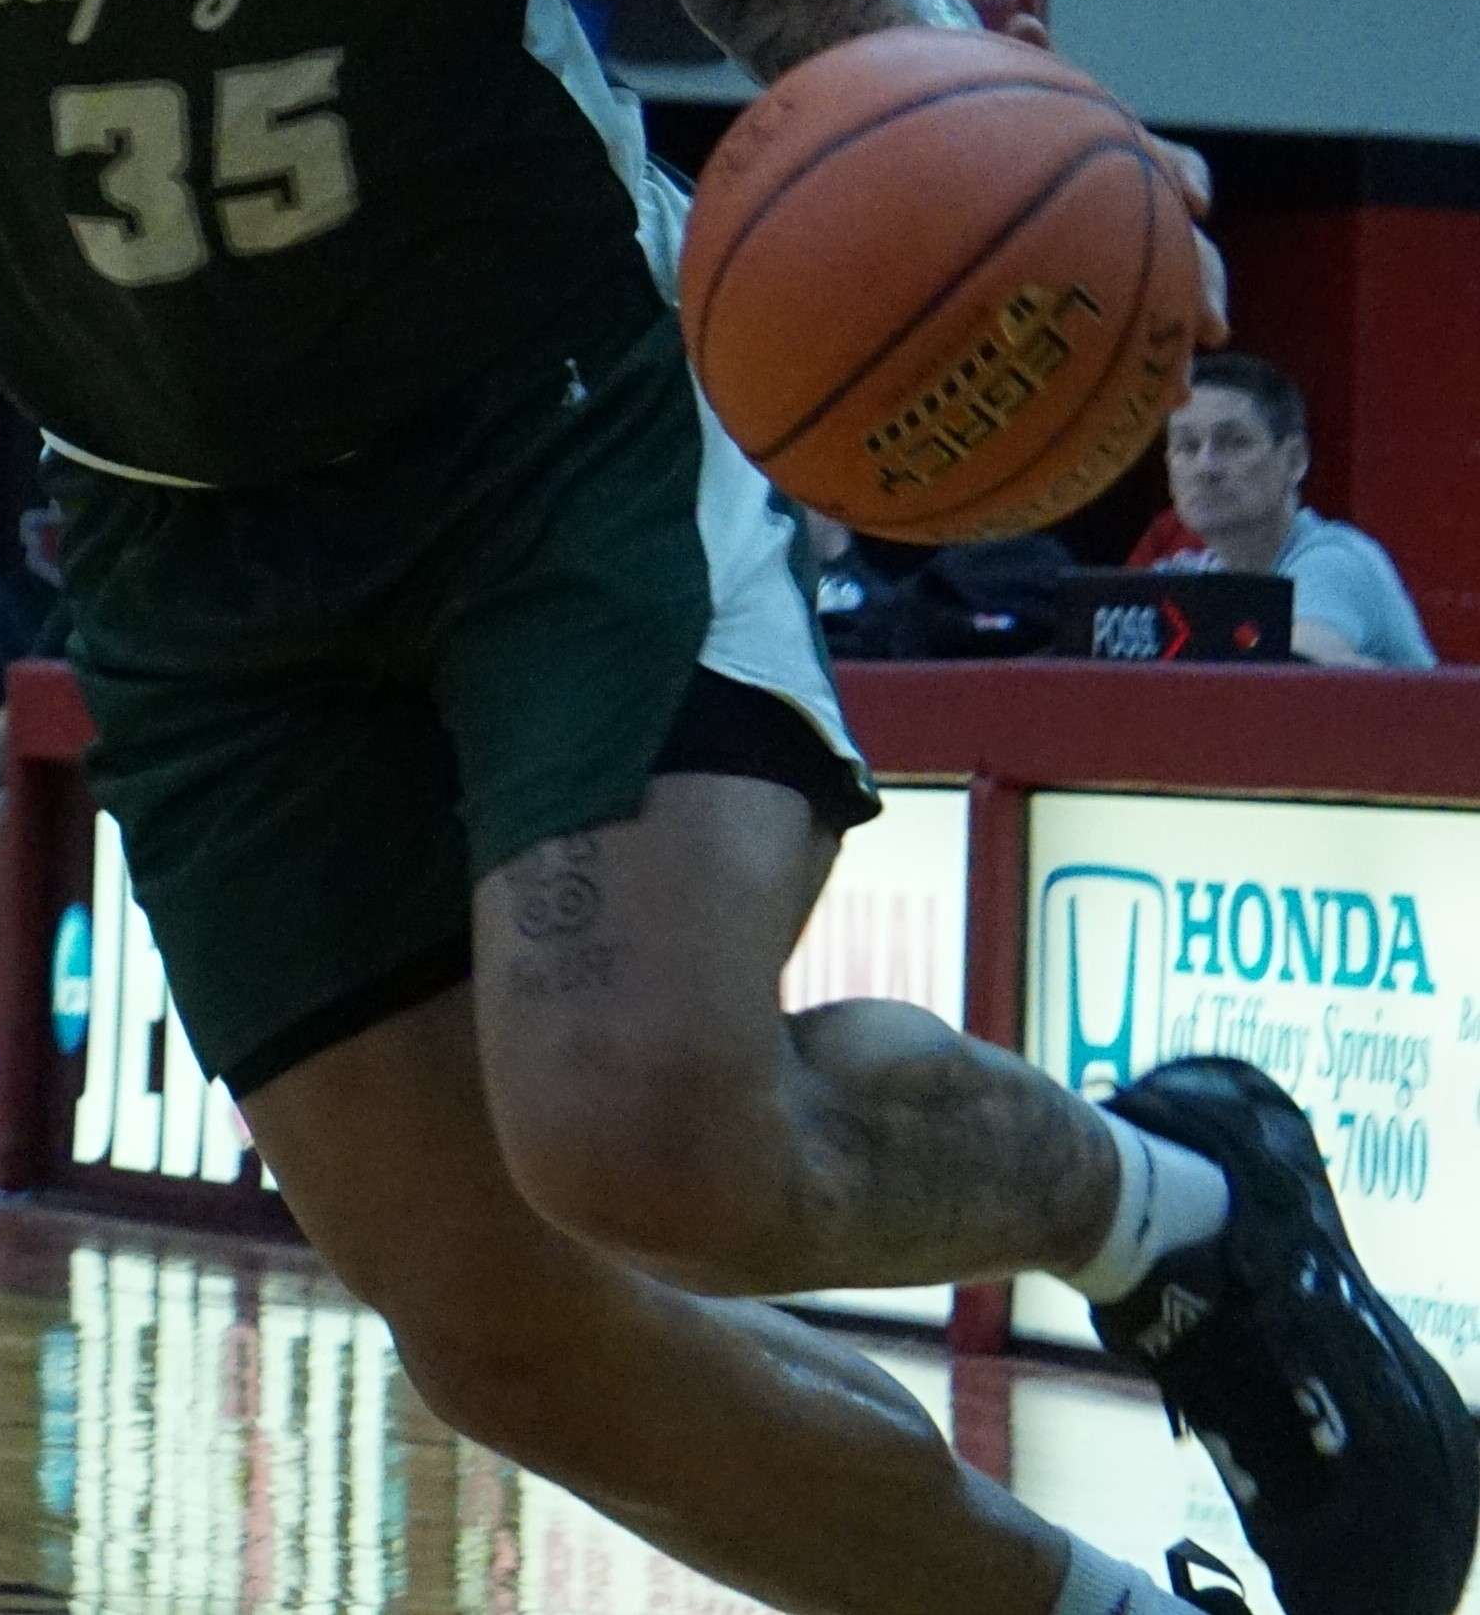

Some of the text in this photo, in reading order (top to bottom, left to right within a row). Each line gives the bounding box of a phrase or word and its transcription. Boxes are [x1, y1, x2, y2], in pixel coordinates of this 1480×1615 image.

[49, 45, 361, 286] 35
[1174, 878, 1438, 996] HONDA
[1210, 993, 1311, 1099] Tiffany
[1316, 1001, 1433, 1109] Springs
